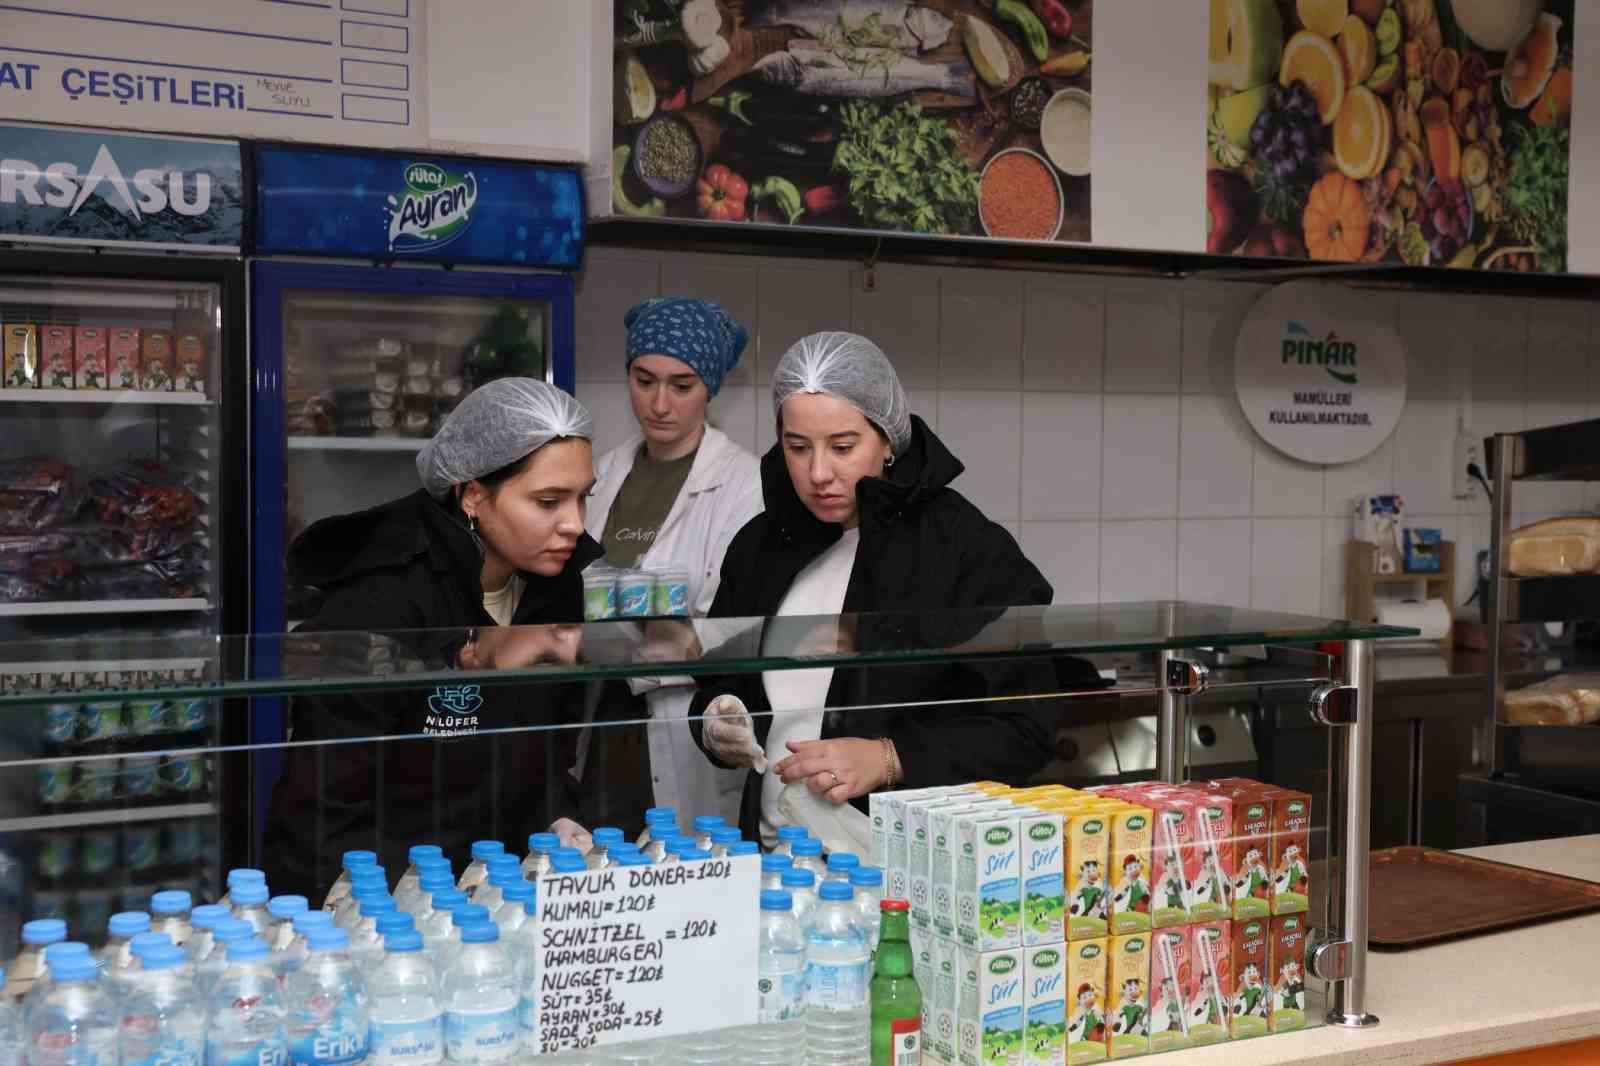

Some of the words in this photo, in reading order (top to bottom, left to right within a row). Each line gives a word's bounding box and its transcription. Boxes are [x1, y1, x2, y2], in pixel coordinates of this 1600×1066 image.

[399, 185, 467, 231] Ayran
[543, 871, 615, 897] TAVUK
[544, 939, 663, 968] (HAMBURGER)
